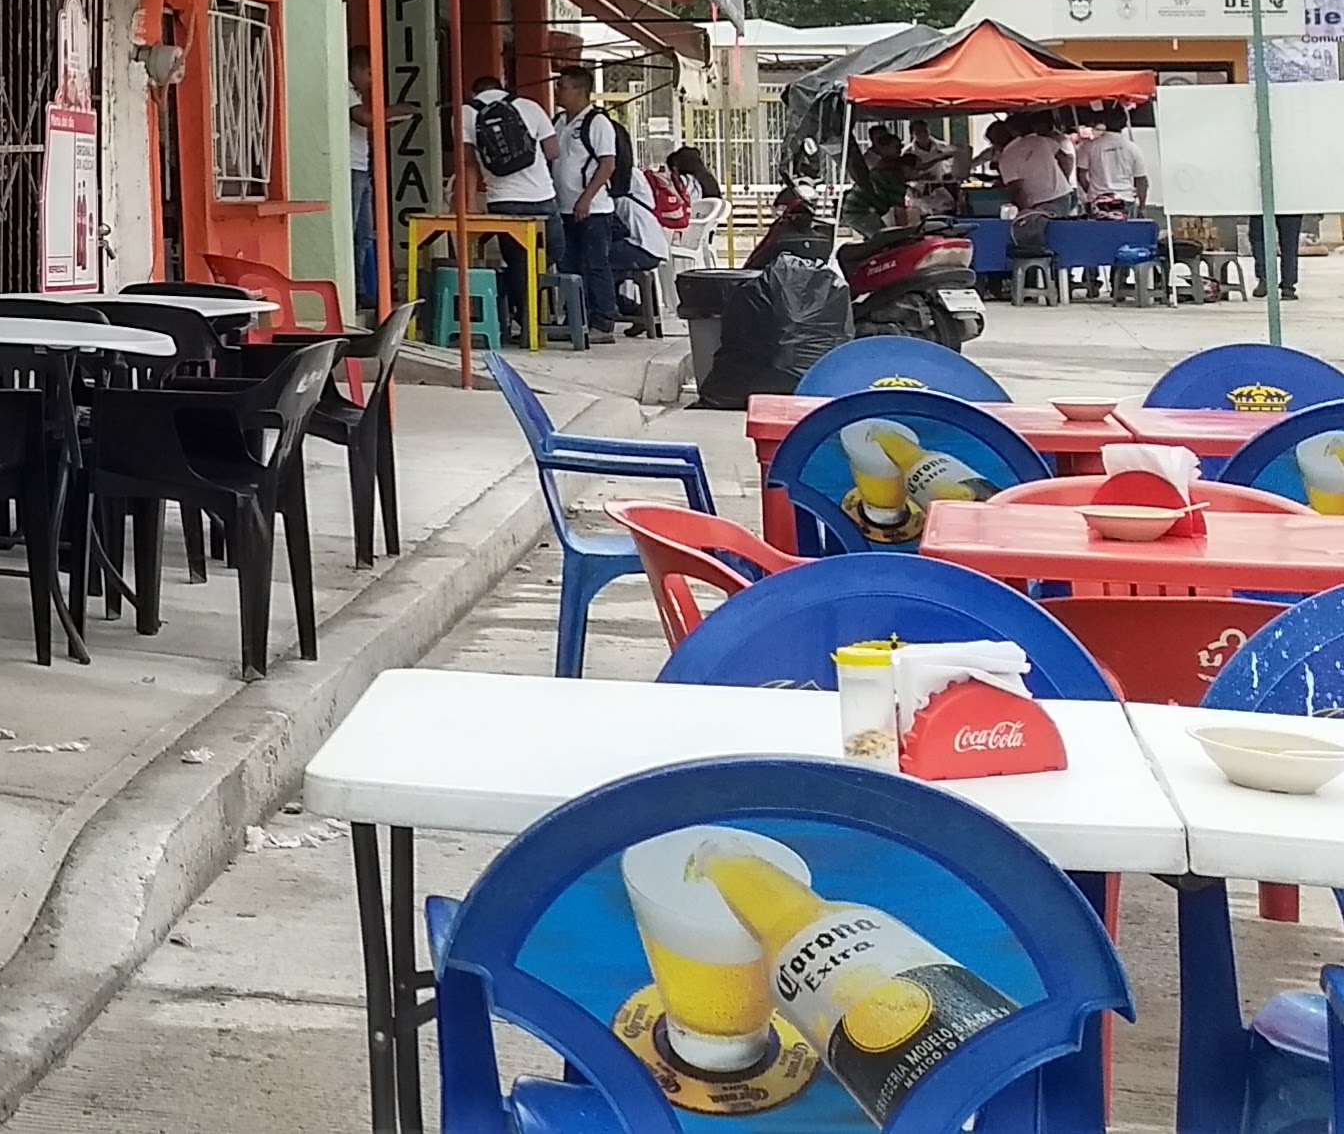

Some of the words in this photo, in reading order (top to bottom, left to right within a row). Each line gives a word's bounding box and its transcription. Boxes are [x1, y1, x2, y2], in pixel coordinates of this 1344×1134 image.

[907, 457, 949, 494] Corona
[776, 917, 881, 1002] Corona
[804, 940, 875, 993] Extra
[905, 1027, 953, 1063] MODELO
